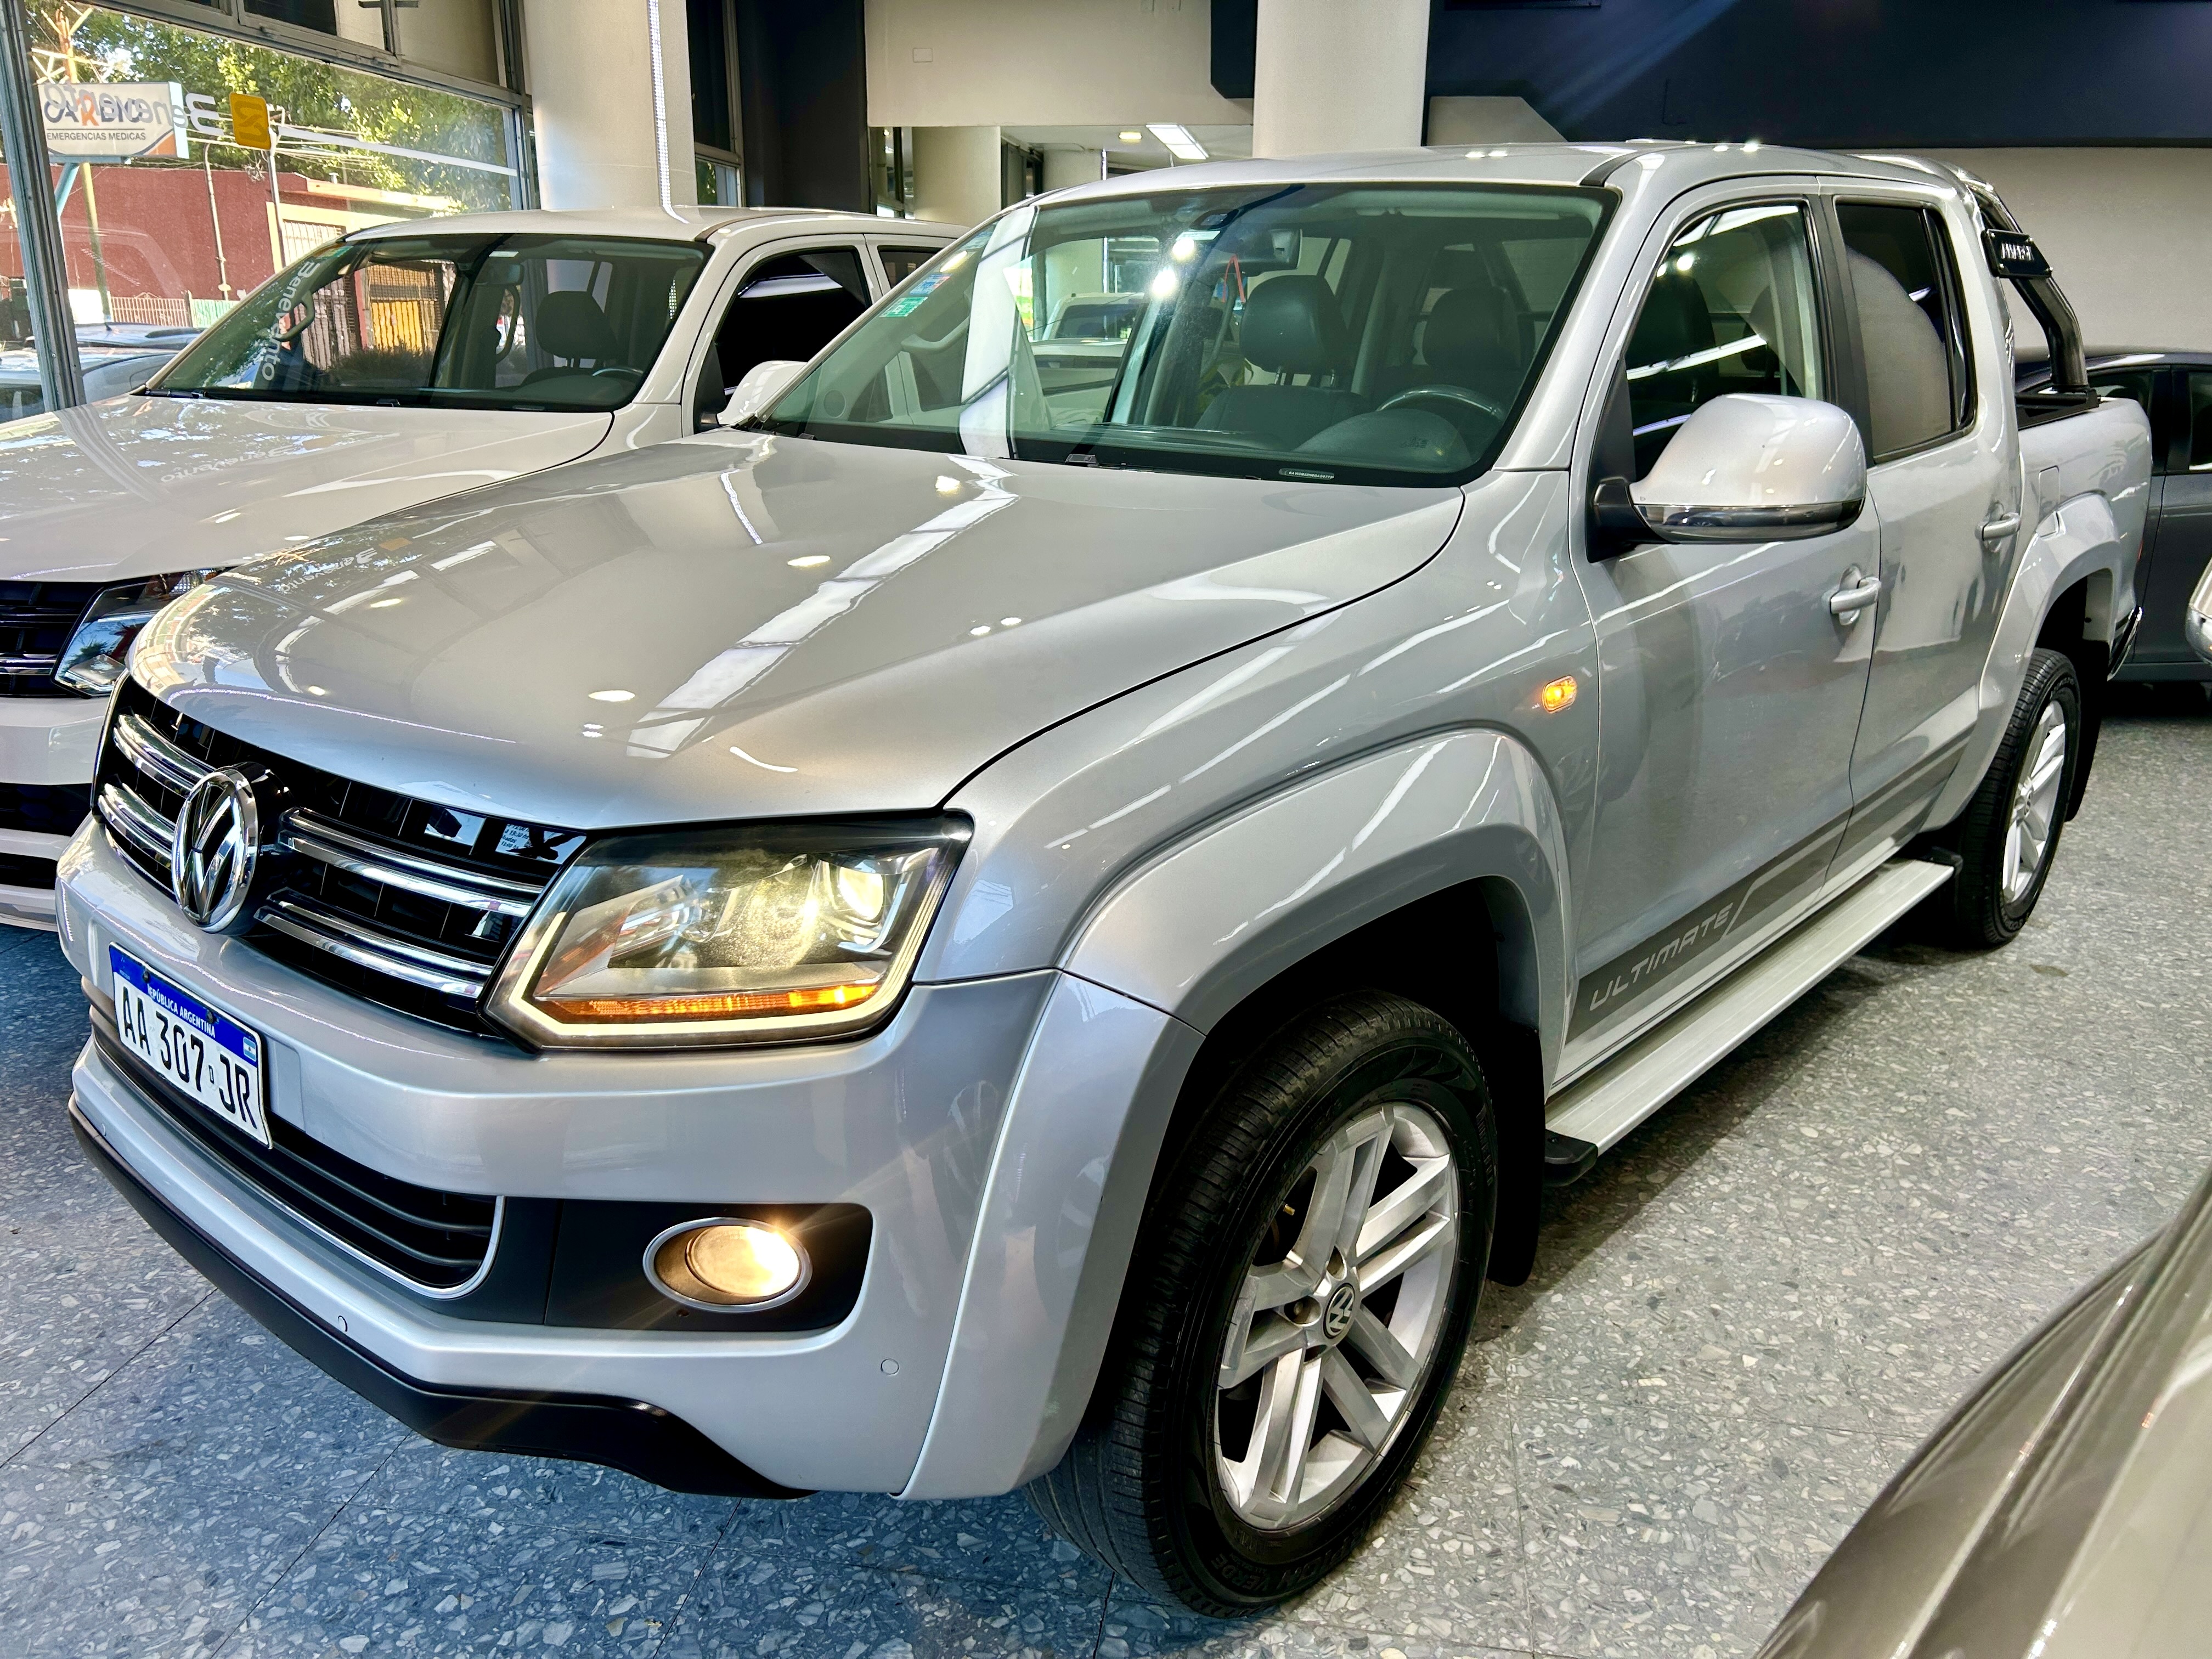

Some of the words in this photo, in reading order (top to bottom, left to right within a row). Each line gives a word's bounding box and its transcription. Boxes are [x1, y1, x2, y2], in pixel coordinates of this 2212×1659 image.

[47, 132, 106, 140] EMERGENCIAS
[1589, 902, 1733, 1011] ULTIMATE
[123, 986, 151, 1056] AA
[156, 1011, 205, 1092] 307
[219, 1054, 257, 1130] JR
[180, 1011, 216, 1038] ARGENTINA
